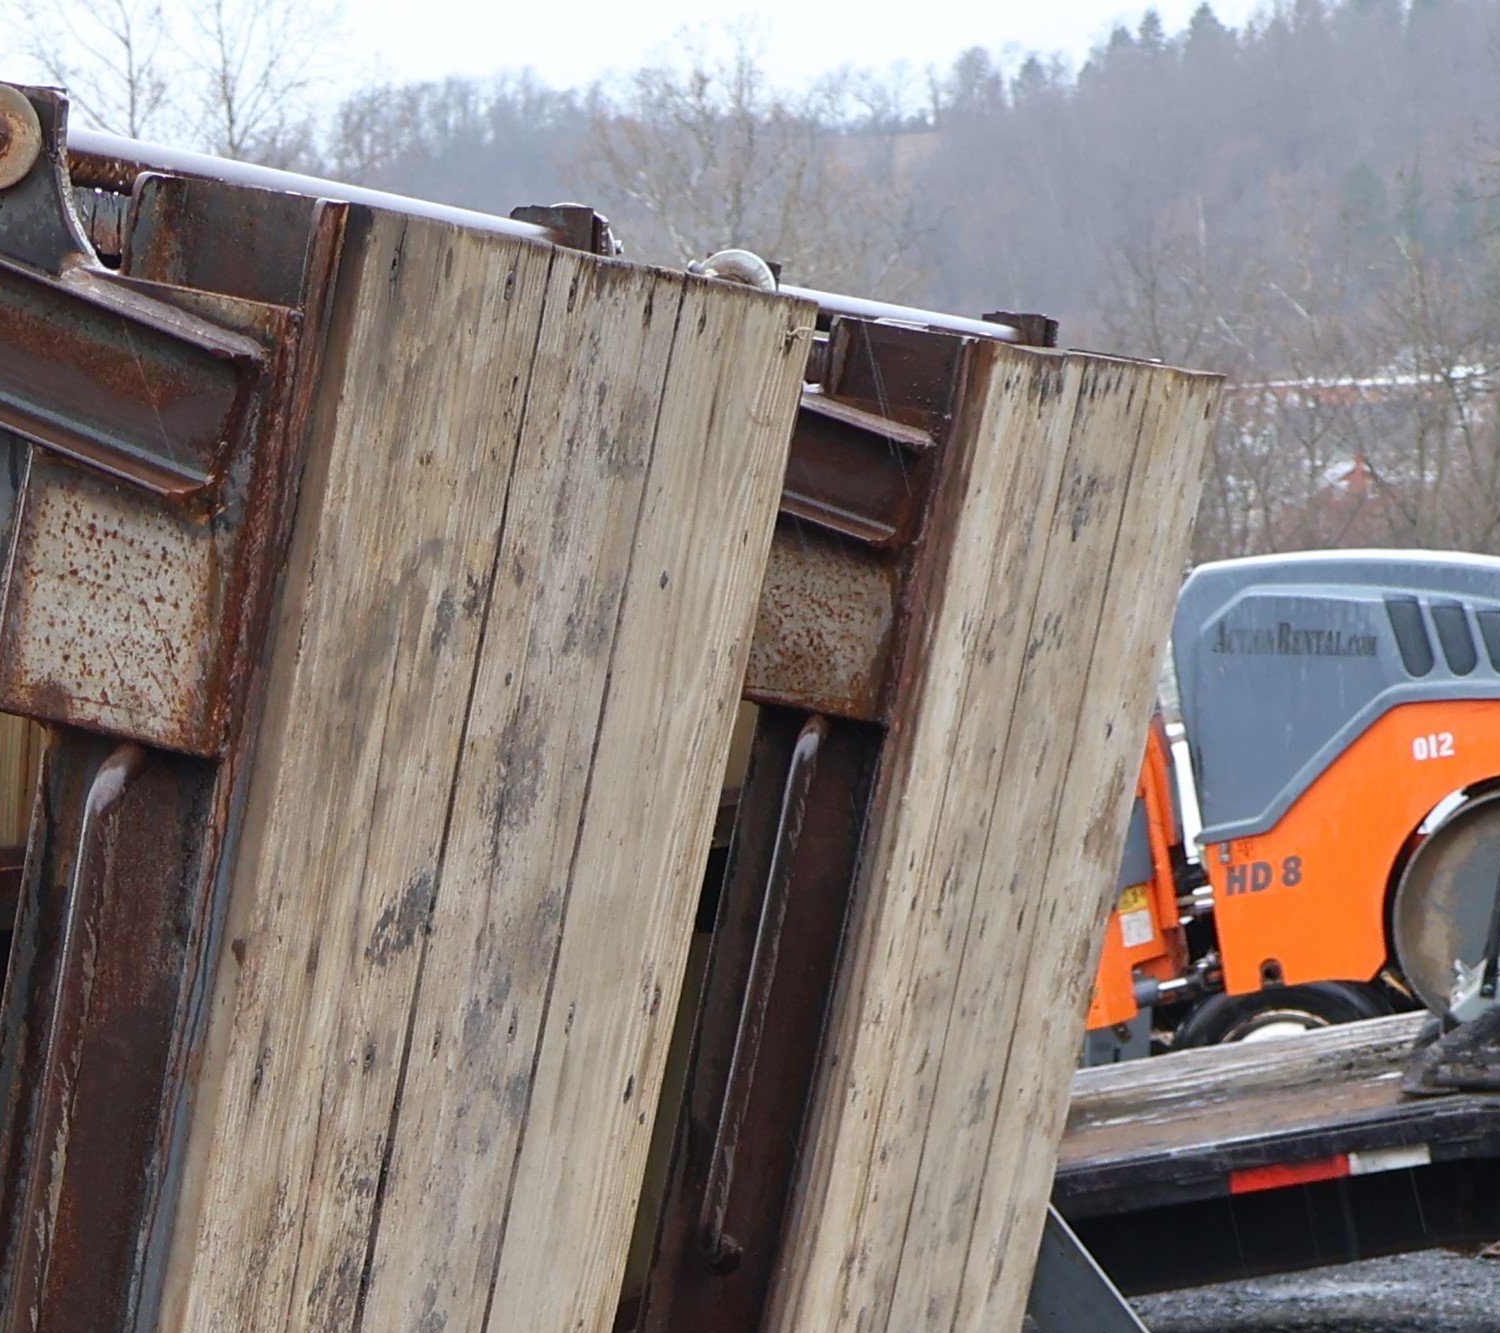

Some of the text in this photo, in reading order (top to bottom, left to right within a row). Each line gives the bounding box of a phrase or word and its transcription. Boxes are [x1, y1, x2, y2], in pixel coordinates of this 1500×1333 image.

[1412, 732, 1455, 761] 012
[1226, 855, 1302, 897] HD 8
